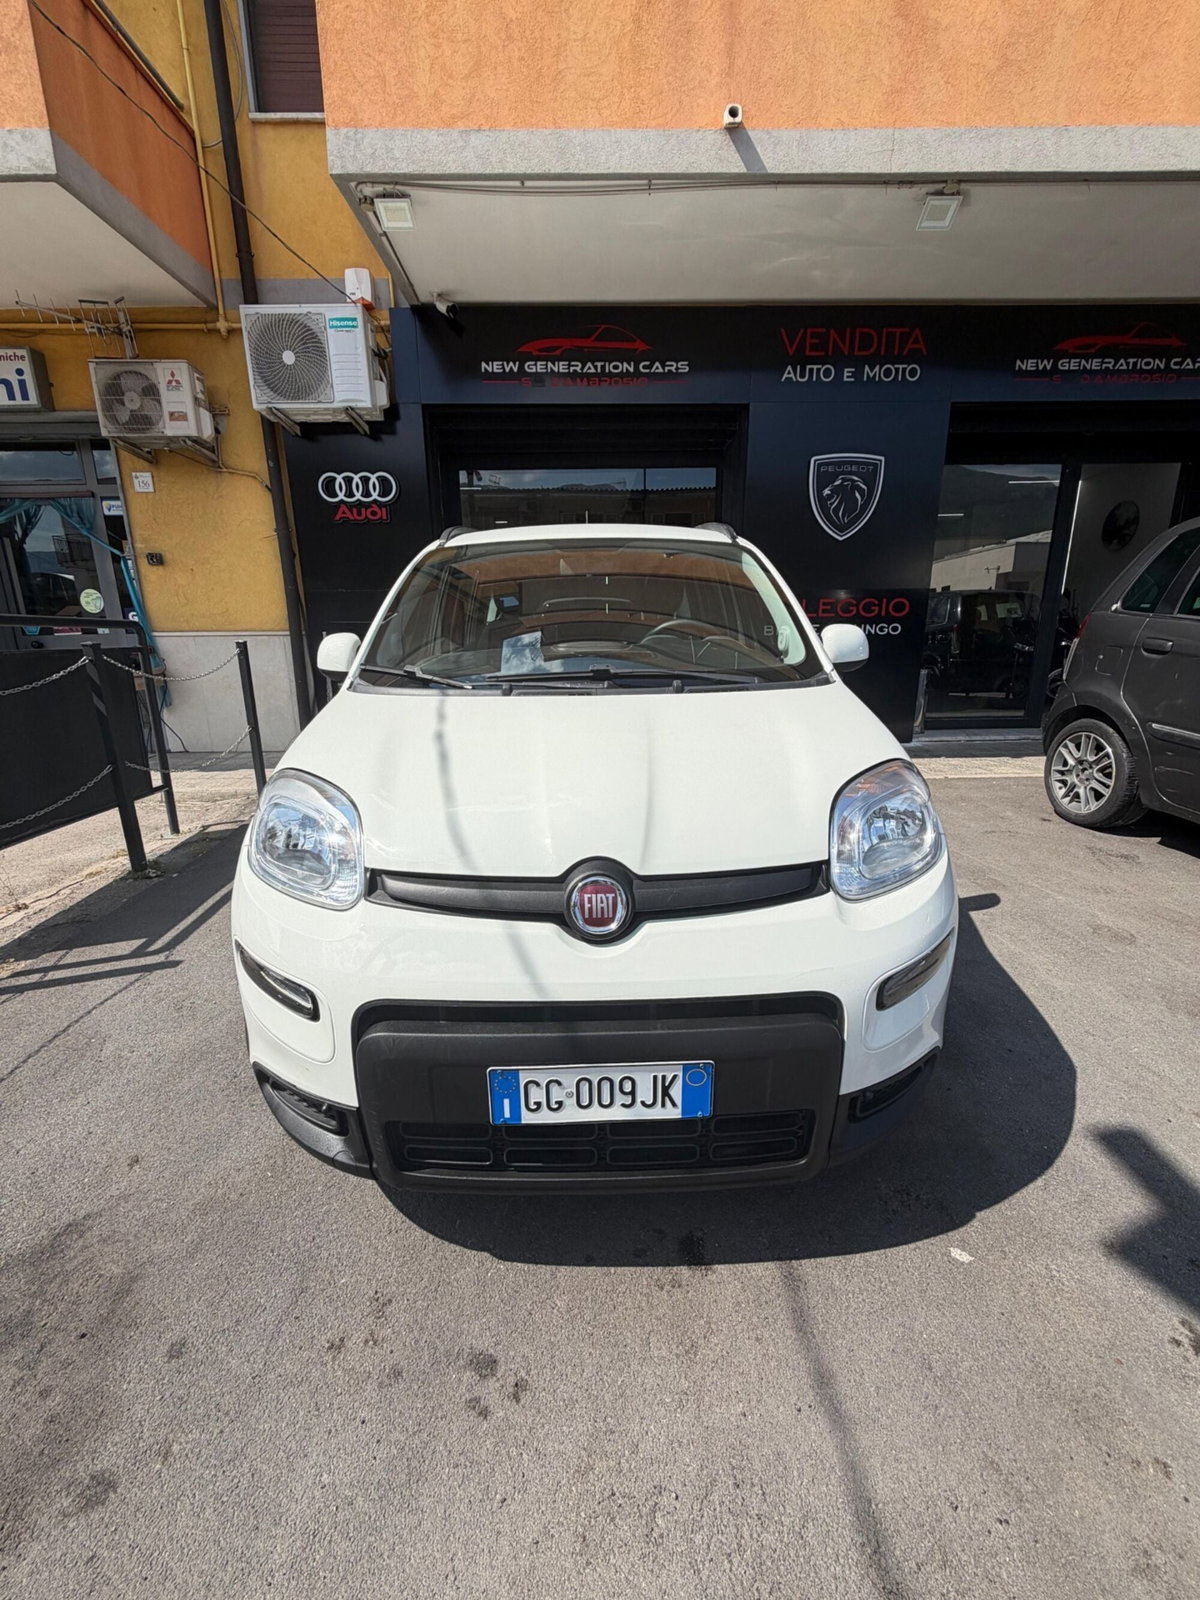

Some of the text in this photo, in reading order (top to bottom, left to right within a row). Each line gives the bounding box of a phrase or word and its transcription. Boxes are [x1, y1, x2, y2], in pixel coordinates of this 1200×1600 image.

[329, 319, 358, 327] Hisense
[780, 327, 928, 356] VENDITA
[481, 361, 689, 373] NEW GENERATION CARS
[781, 364, 921, 382] AUTO E MOTO
[1015, 359, 1053, 371] NEW
[1057, 358, 1165, 371] GENERATION
[820, 465, 875, 473] PEUGEOT
[334, 502, 387, 521] Audi
[801, 598, 910, 617] LEGGIO
[583, 893, 615, 918] FIAT
